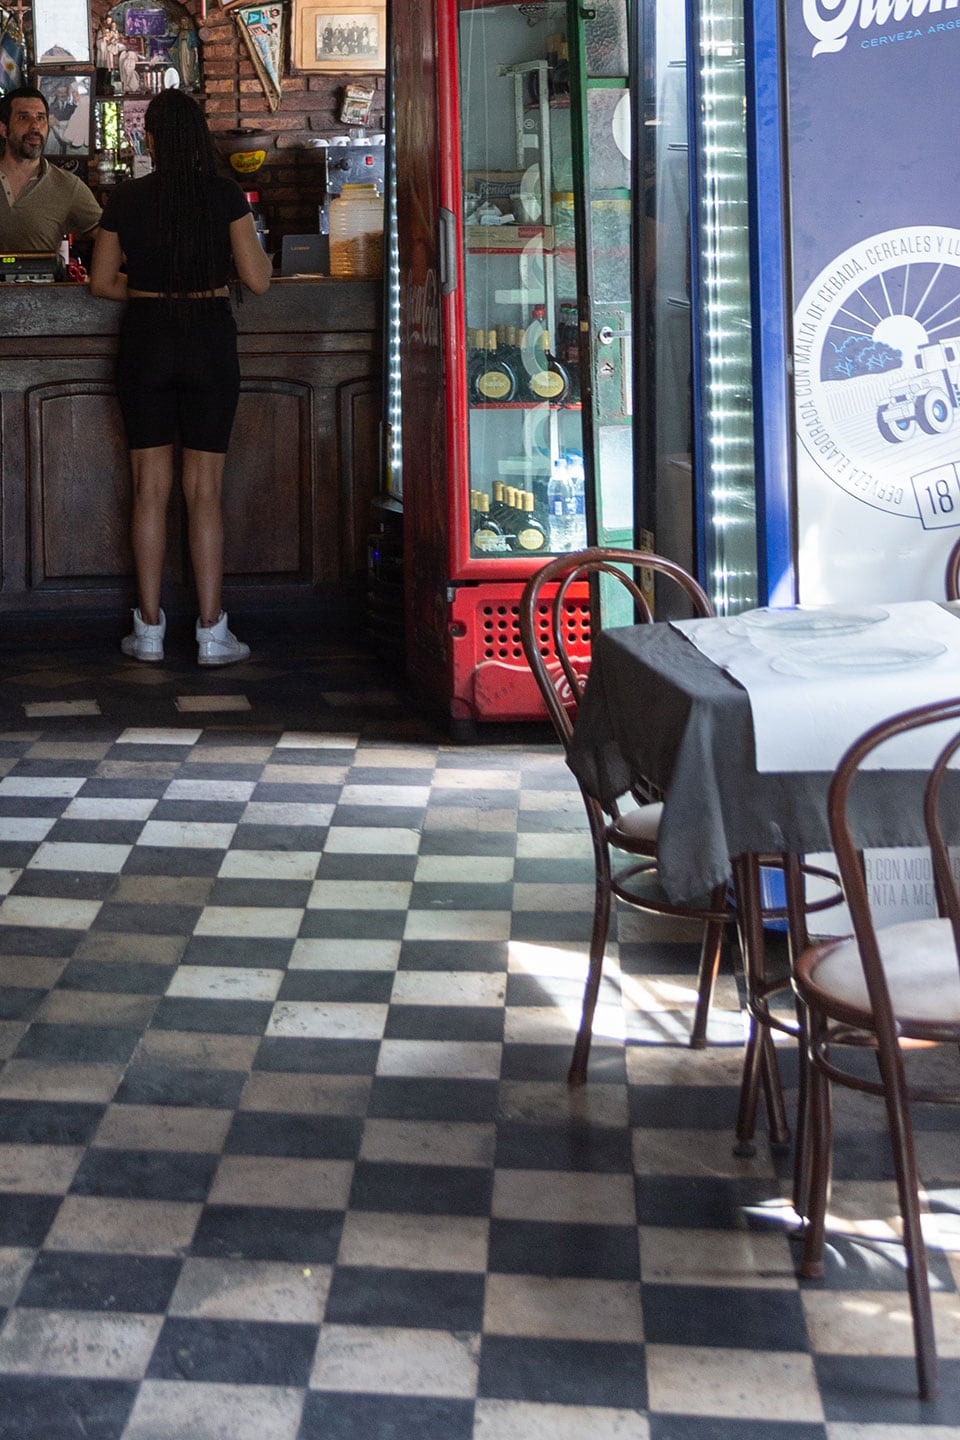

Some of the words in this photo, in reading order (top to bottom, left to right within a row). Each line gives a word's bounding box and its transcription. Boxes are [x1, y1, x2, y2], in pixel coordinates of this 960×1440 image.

[860, 28, 923, 49] CERVEZA
[865, 235, 931, 265] CEREALES
[936, 236, 944, 253] Y
[806, 301, 827, 321] DE
[794, 322, 818, 365] MALTA
[794, 369, 813, 397] CON
[799, 399, 851, 473] ELABORADA
[848, 467, 904, 505] CERVEZA
[924, 479, 954, 515] 18
[875, 858, 900, 881] CON
[900, 883, 910, 906] A
